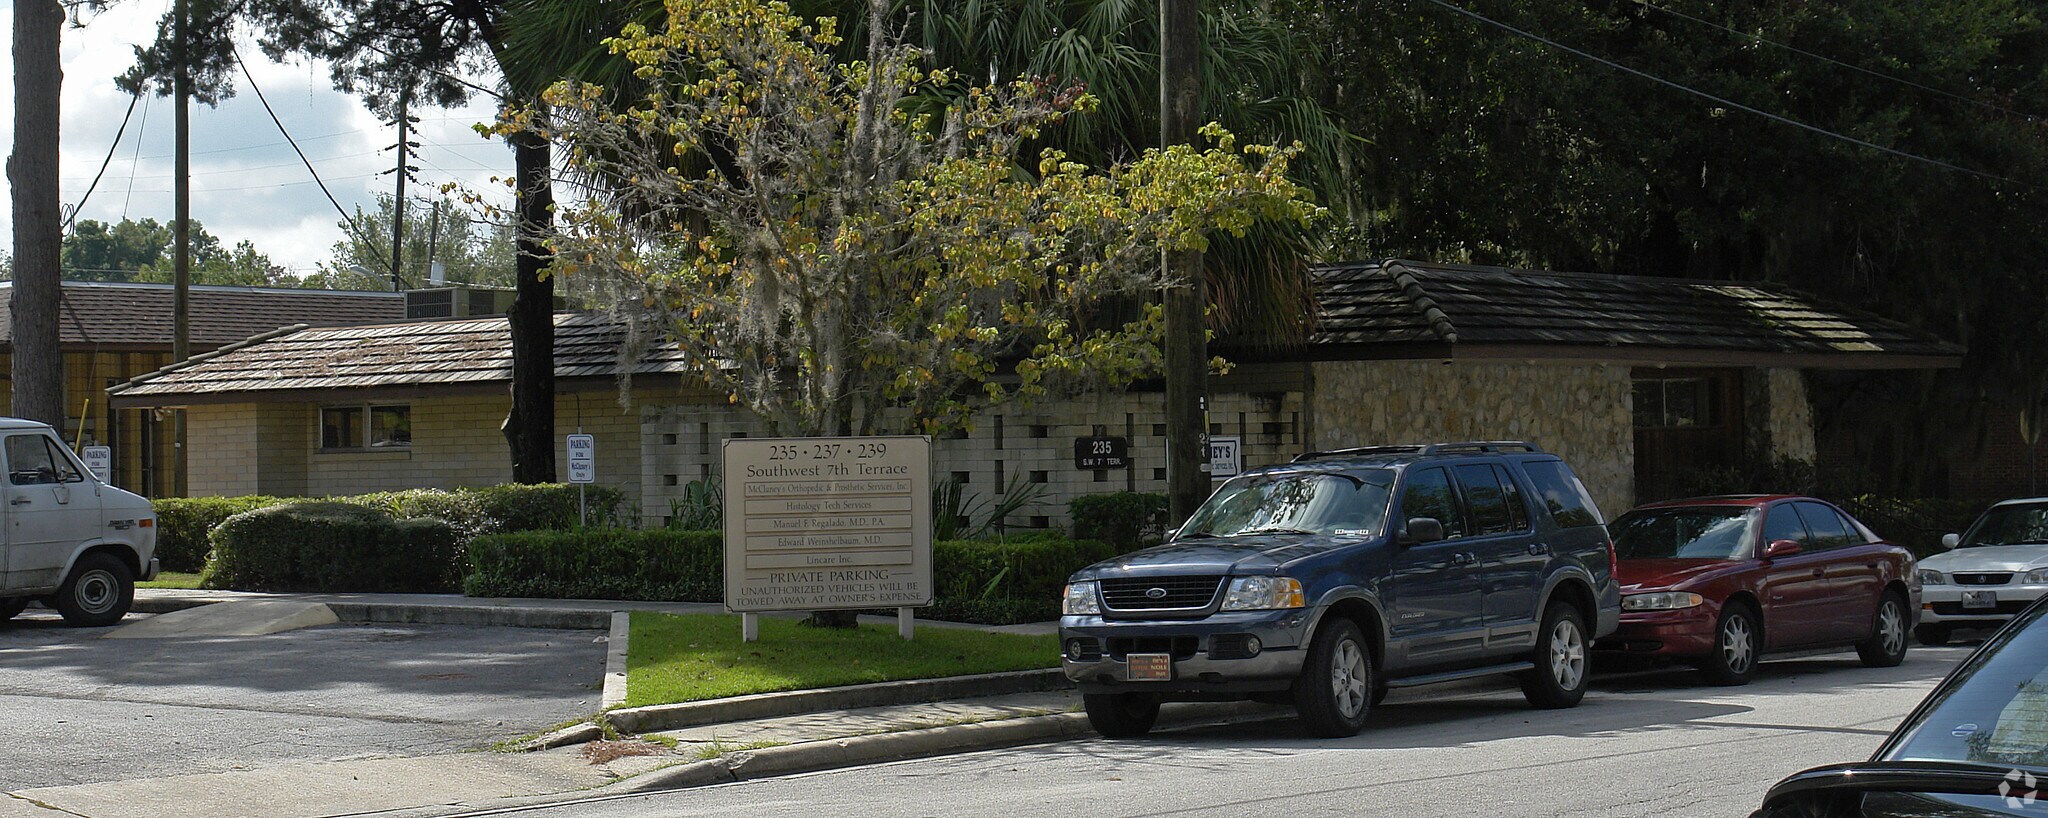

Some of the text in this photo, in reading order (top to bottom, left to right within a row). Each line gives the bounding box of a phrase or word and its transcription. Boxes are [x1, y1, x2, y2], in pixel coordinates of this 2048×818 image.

[571, 440, 590, 448] PARKING
[1093, 441, 1112, 454] 235
[86, 450, 107, 459] PARKING
[769, 443, 887, 460] 235 237 239
[747, 463, 908, 477] Southwest 7th Terrace
[788, 483, 824, 495] Orthopedic
[786, 500, 872, 512] Histology Tech Services
[774, 520, 801, 529] Manuel
[778, 537, 805, 547] Edward
[806, 554, 854, 565] Lincare Inc.
[770, 569, 889, 583] PRIVATE PARKING
[741, 581, 919, 596] UNAUTHORIZED VEHICLES WILL BE
[736, 597, 774, 606] TOWED
[778, 596, 807, 605] AWAY
[811, 595, 824, 603] AT
[828, 593, 876, 603] OWNER'S
